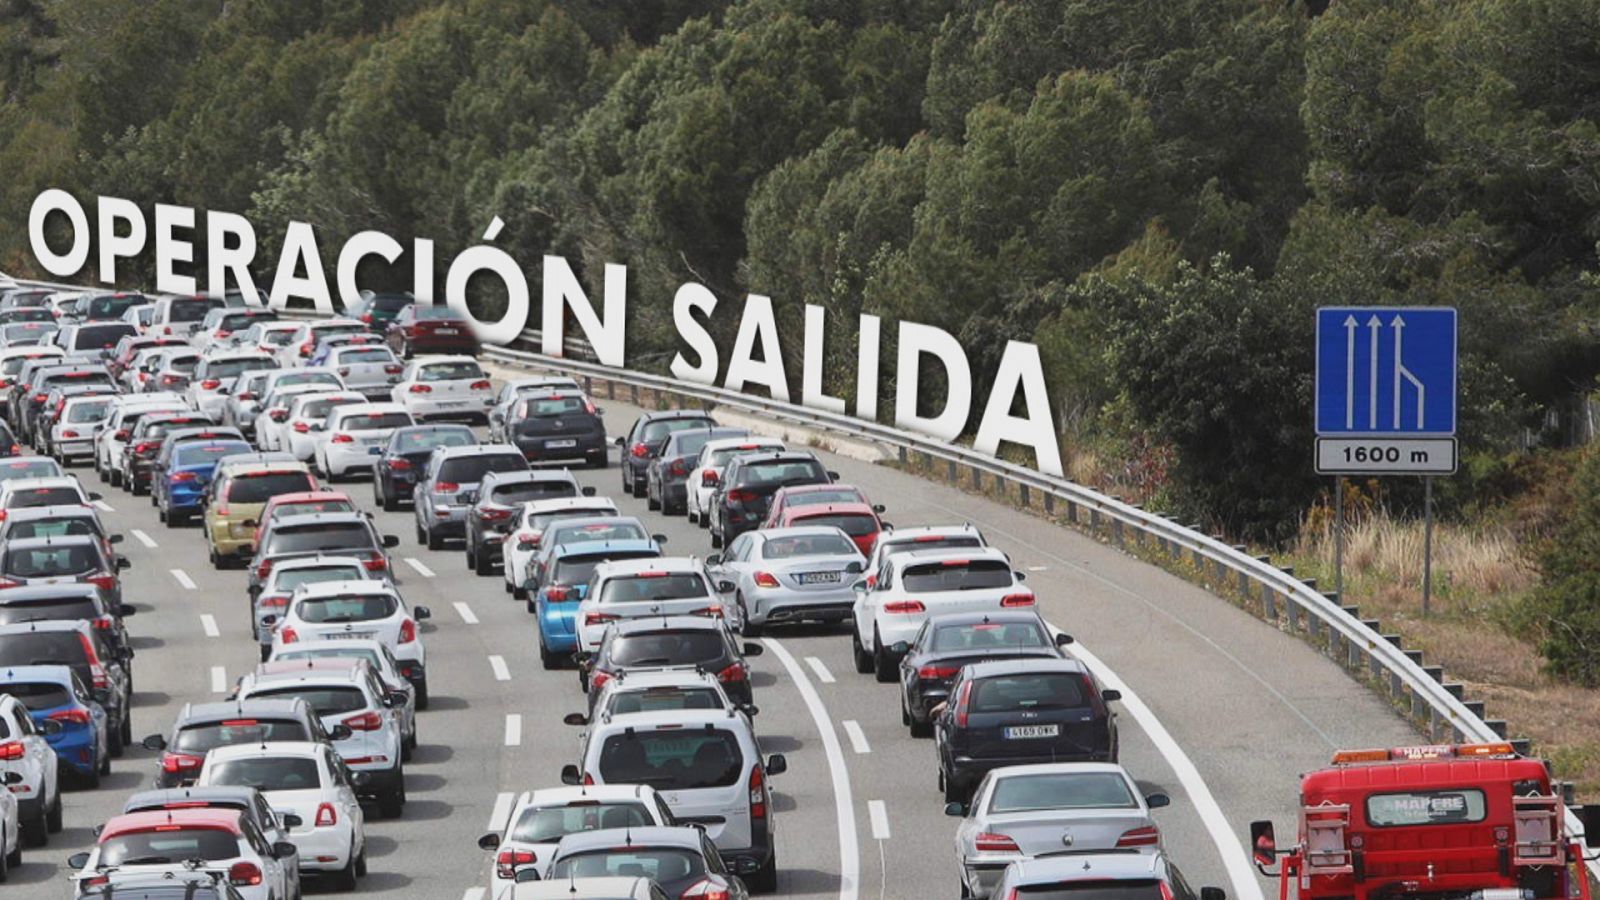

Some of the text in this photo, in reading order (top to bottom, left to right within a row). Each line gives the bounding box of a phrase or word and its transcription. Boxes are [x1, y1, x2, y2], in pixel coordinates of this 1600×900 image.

[1343, 446, 1429, 463] 1600 m
[1393, 796, 1465, 811] MAPFRE
